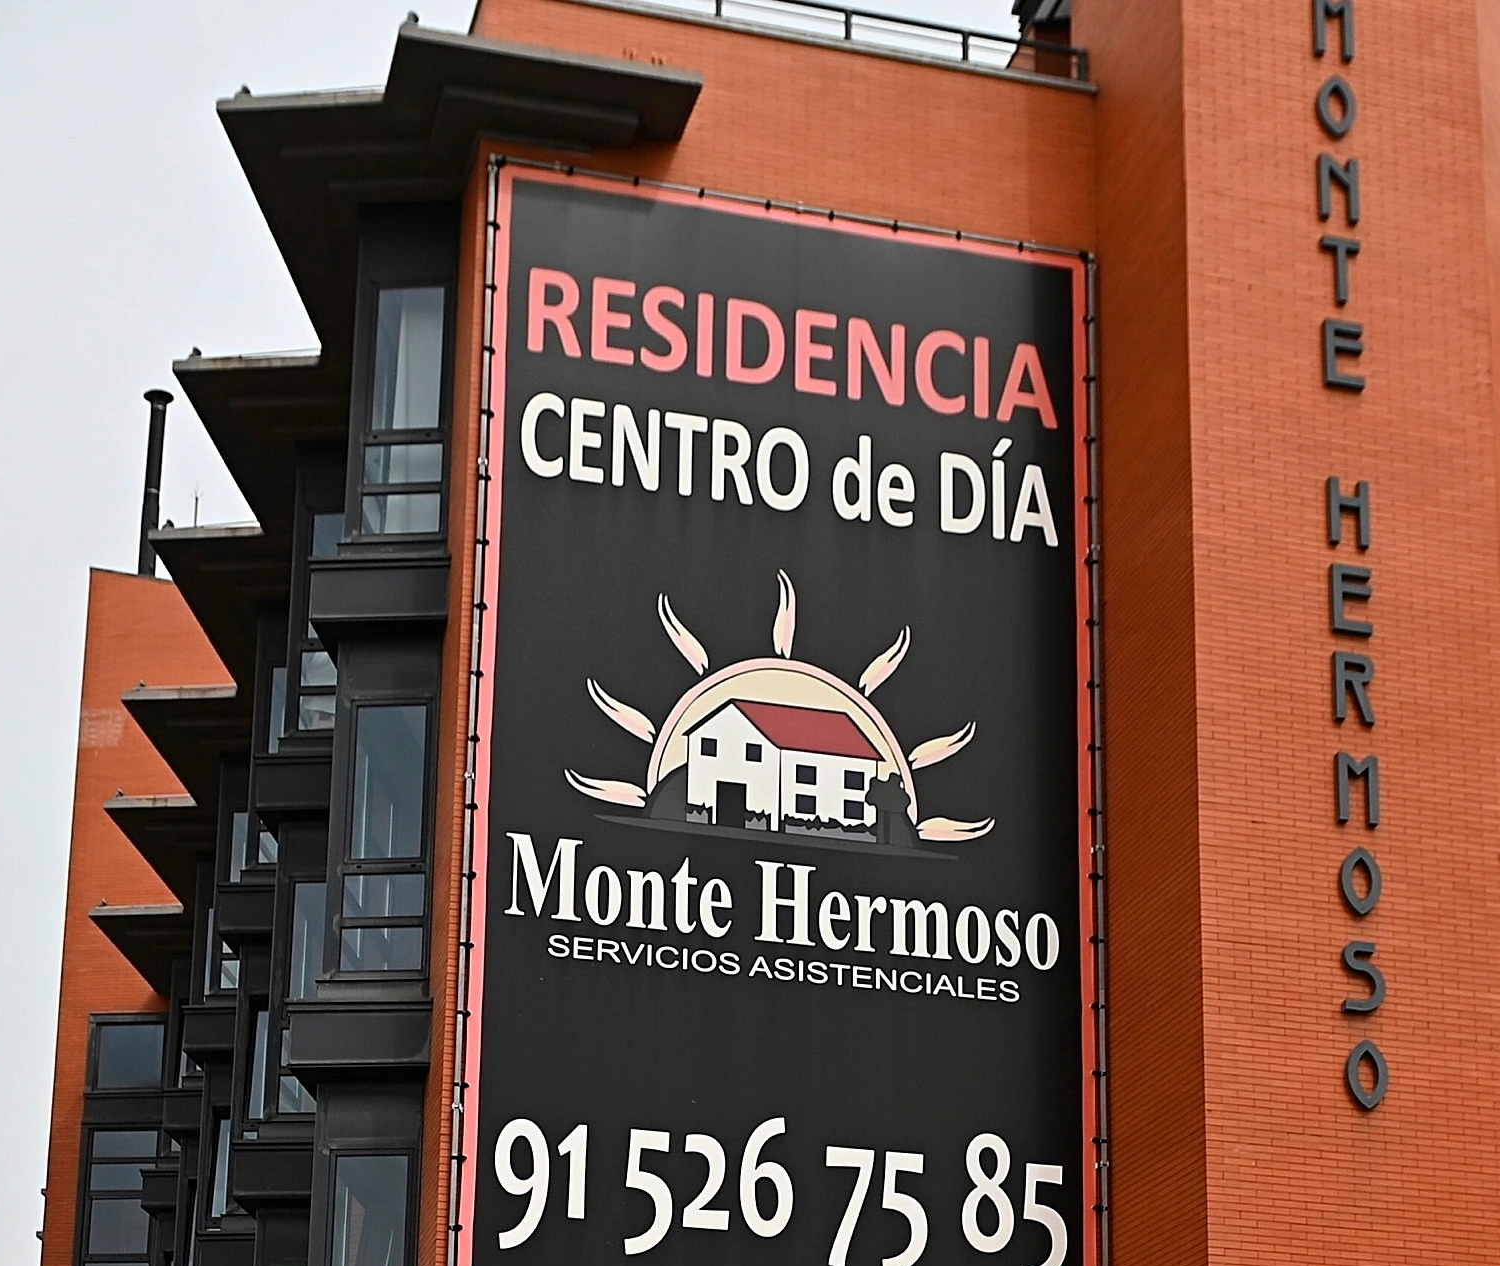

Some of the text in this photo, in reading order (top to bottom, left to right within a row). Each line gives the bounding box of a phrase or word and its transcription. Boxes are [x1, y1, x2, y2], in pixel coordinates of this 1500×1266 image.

[526, 266, 1059, 430] RESIDENCIA
[520, 392, 1060, 548] CENTRO de DÍA
[1312, 0, 1389, 1110] MONTE HERMOSO
[503, 832, 1061, 972] Monte Hermoso
[547, 934, 1021, 1004] SERVICIOS ASISTENCIALES
[494, 1118, 588, 1251] 91
[623, 1117, 795, 1256] 526
